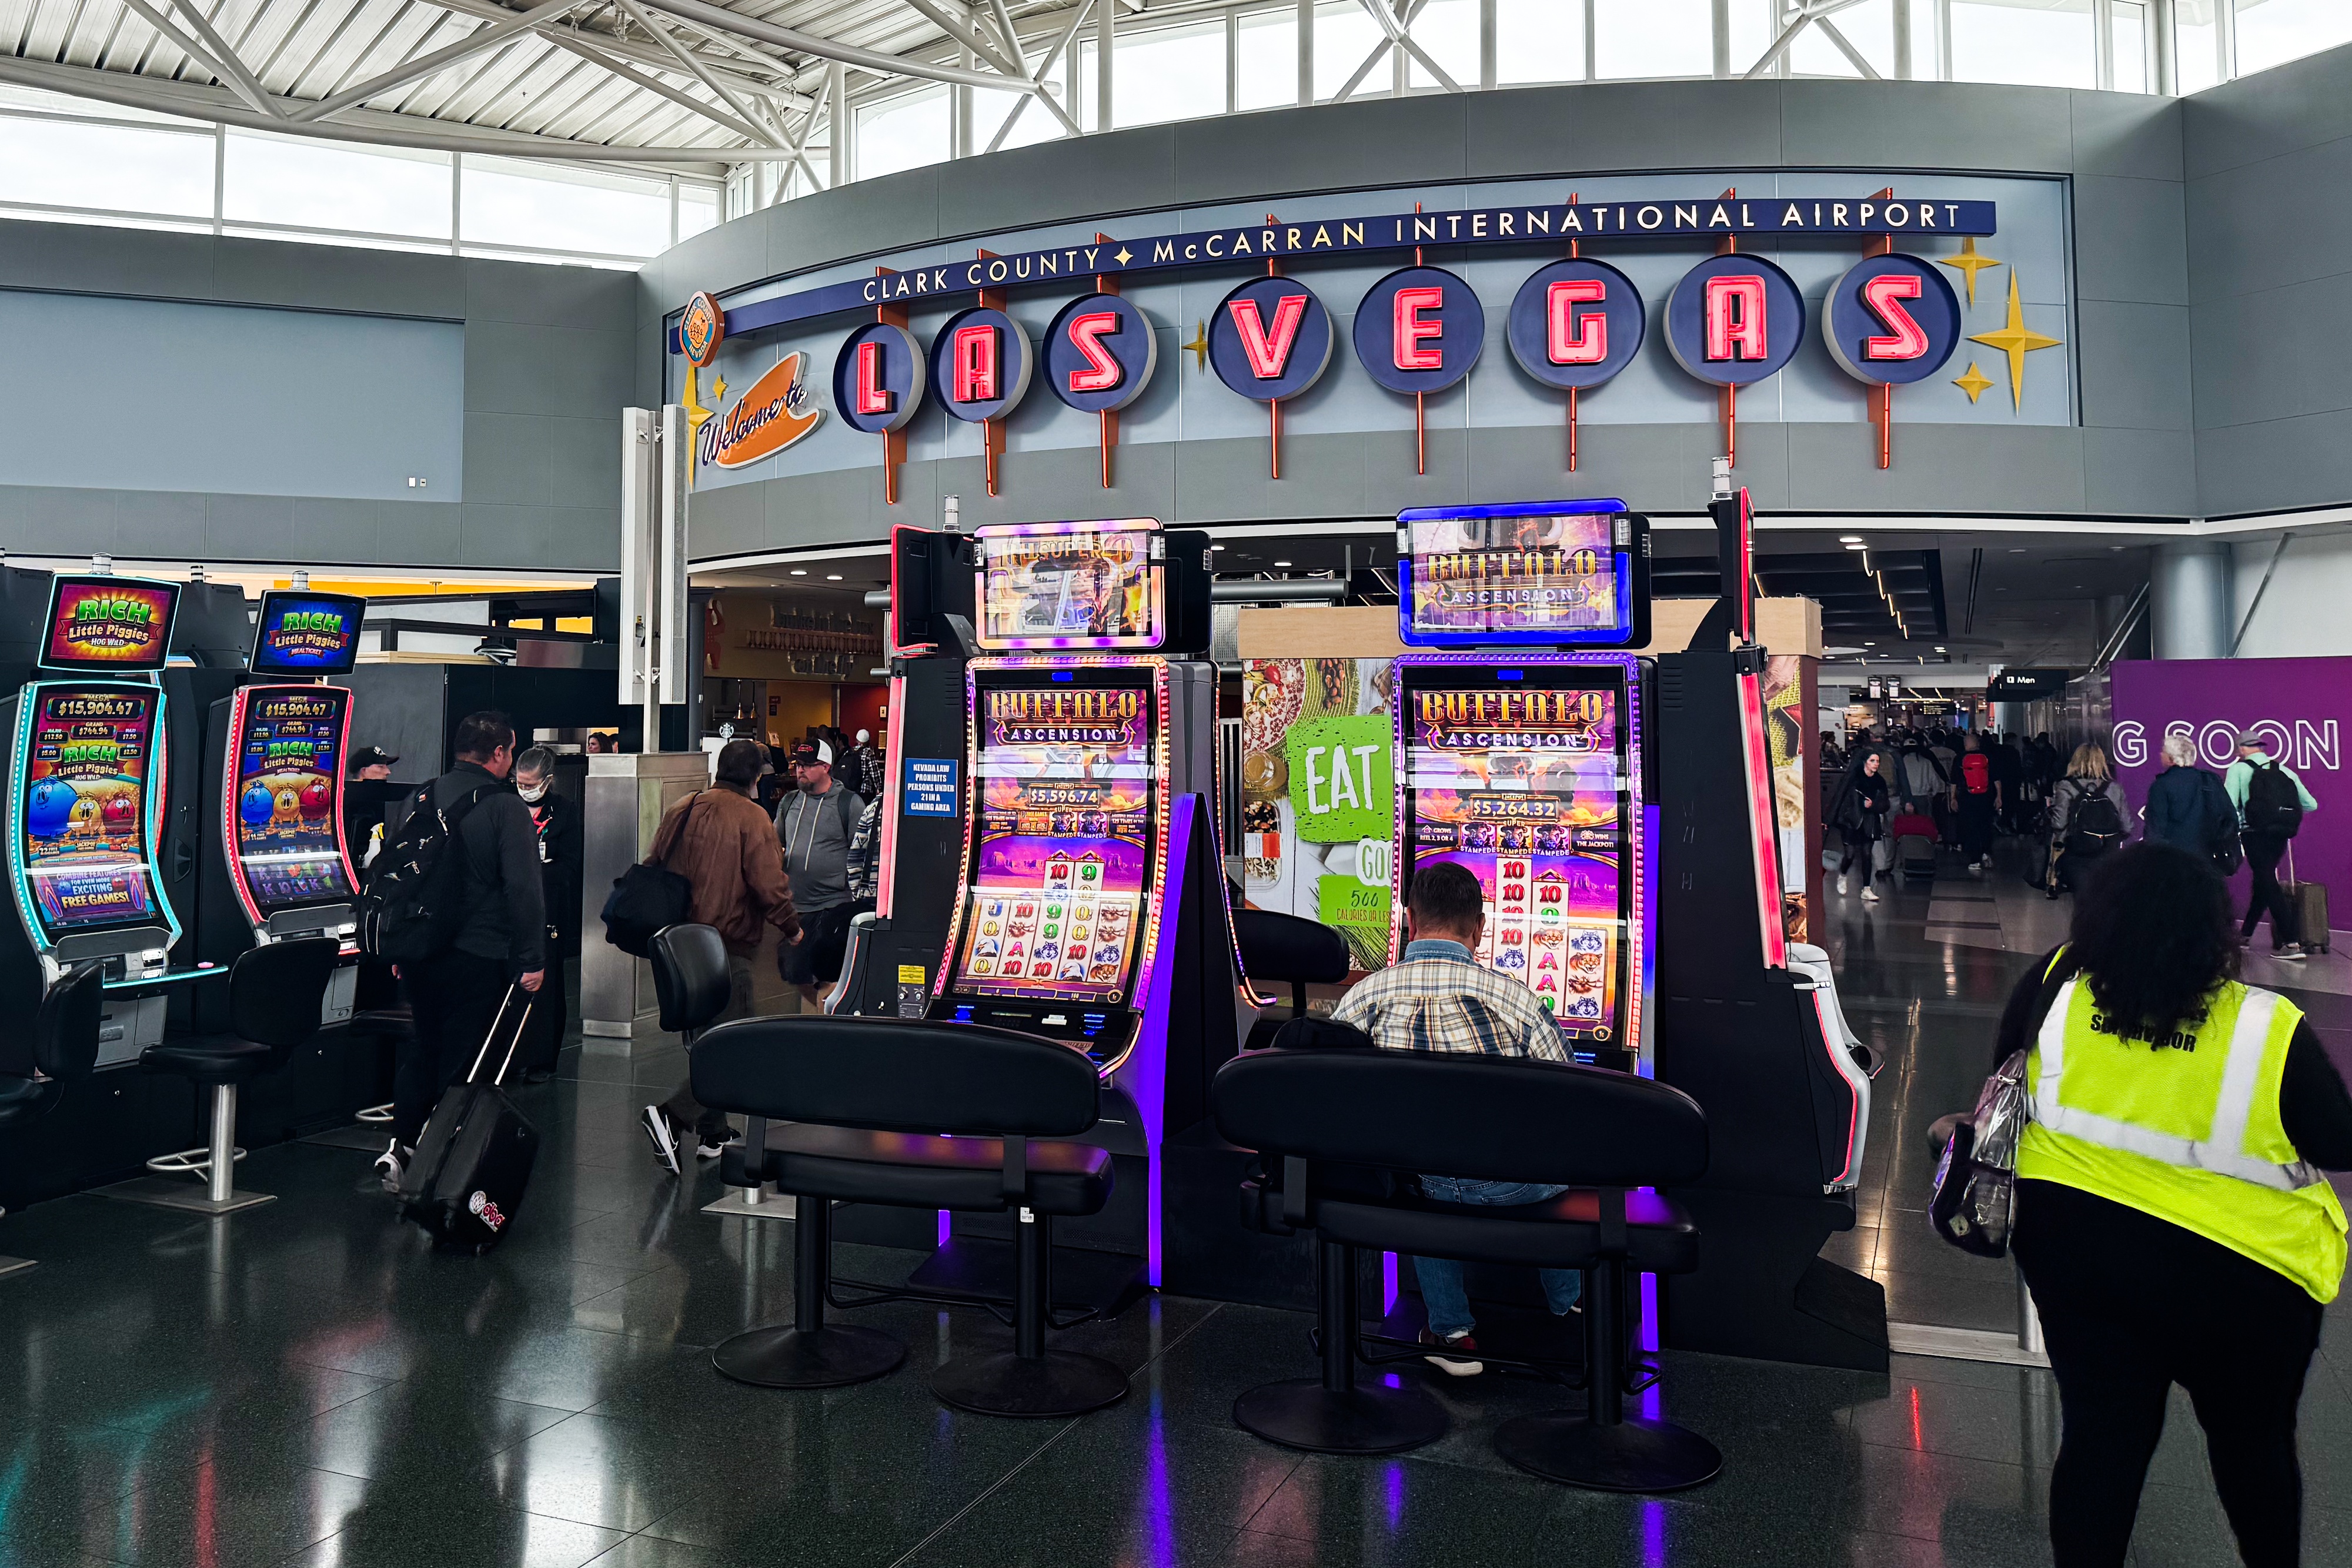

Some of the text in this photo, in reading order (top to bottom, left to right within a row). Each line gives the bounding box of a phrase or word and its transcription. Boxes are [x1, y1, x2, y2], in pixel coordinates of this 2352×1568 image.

[863, 202, 1959, 301] CLARK COUNTY McCARRAN INTERNATIONAL AIRPORT
[684, 299, 713, 330] CLARK COUNTY
[689, 340, 708, 359] NEVADA
[857, 274, 1930, 414] LAS VEGAS
[699, 398, 786, 466] Welcome
[1428, 549, 1596, 581] BUFFALO
[1450, 589, 1572, 603] ASCENSION
[78, 599, 151, 626] RICH
[283, 612, 343, 634] RICH
[68, 624, 149, 642] Little Piggies
[275, 634, 341, 649] Little Piggies
[59, 701, 133, 716] $15,904.47
[266, 703, 326, 717] $15,904.47
[990, 691, 1137, 718] BUFFALO
[1421, 691, 1603, 723] BUFFALO
[1010, 728, 1117, 741] ASCENSION
[1446, 733, 1577, 747] ASCENSION
[64, 745, 117, 763] RICH
[269, 741, 313, 758] RICH
[58, 764, 118, 777] Little Piggies
[264, 757, 314, 769] Little Piggies
[913, 764, 936, 773] NEVADA
[915, 774, 947, 783] PROHIBITS
[1307, 745, 1379, 815] EAT
[907, 783, 955, 792] PERSONS UNDER
[1031, 788, 1098, 804] $5,596.74
[921, 793, 928, 801] 21
[911, 803, 951, 812] GAMING AREA
[1473, 800, 1556, 817] $5,264.32
[1460, 845, 1496, 854] STAMPEDE
[1532, 848, 1570, 857] STAMPEDE
[1050, 864, 1069, 881] 10
[1081, 864, 1097, 881] 9
[1503, 861, 1526, 880] 10
[72, 883, 113, 895] EXCITING
[1502, 883, 1525, 902] 10
[1539, 885, 1562, 904] 10
[61, 891, 130, 909] FREE GAMES!
[1351, 890, 1379, 908] 500
[1015, 902, 1034, 918] 10
[1046, 903, 1062, 920] 9
[1074, 904, 1093, 921] Q
[1337, 908, 1368, 922] CALORIES
[1369, 910, 1377, 922] OR
[983, 920, 1000, 937] Q
[1043, 922, 1059, 940] 9
[1071, 924, 1090, 941] Q
[1501, 928, 1524, 947] 10
[1007, 941, 1025, 957] A
[1067, 944, 1087, 961] 10
[973, 958, 991, 974] Q
[1002, 960, 1022, 976] 10
[1033, 961, 1053, 977] 10
[1537, 952, 1559, 971] A
[1535, 974, 1558, 992] A
